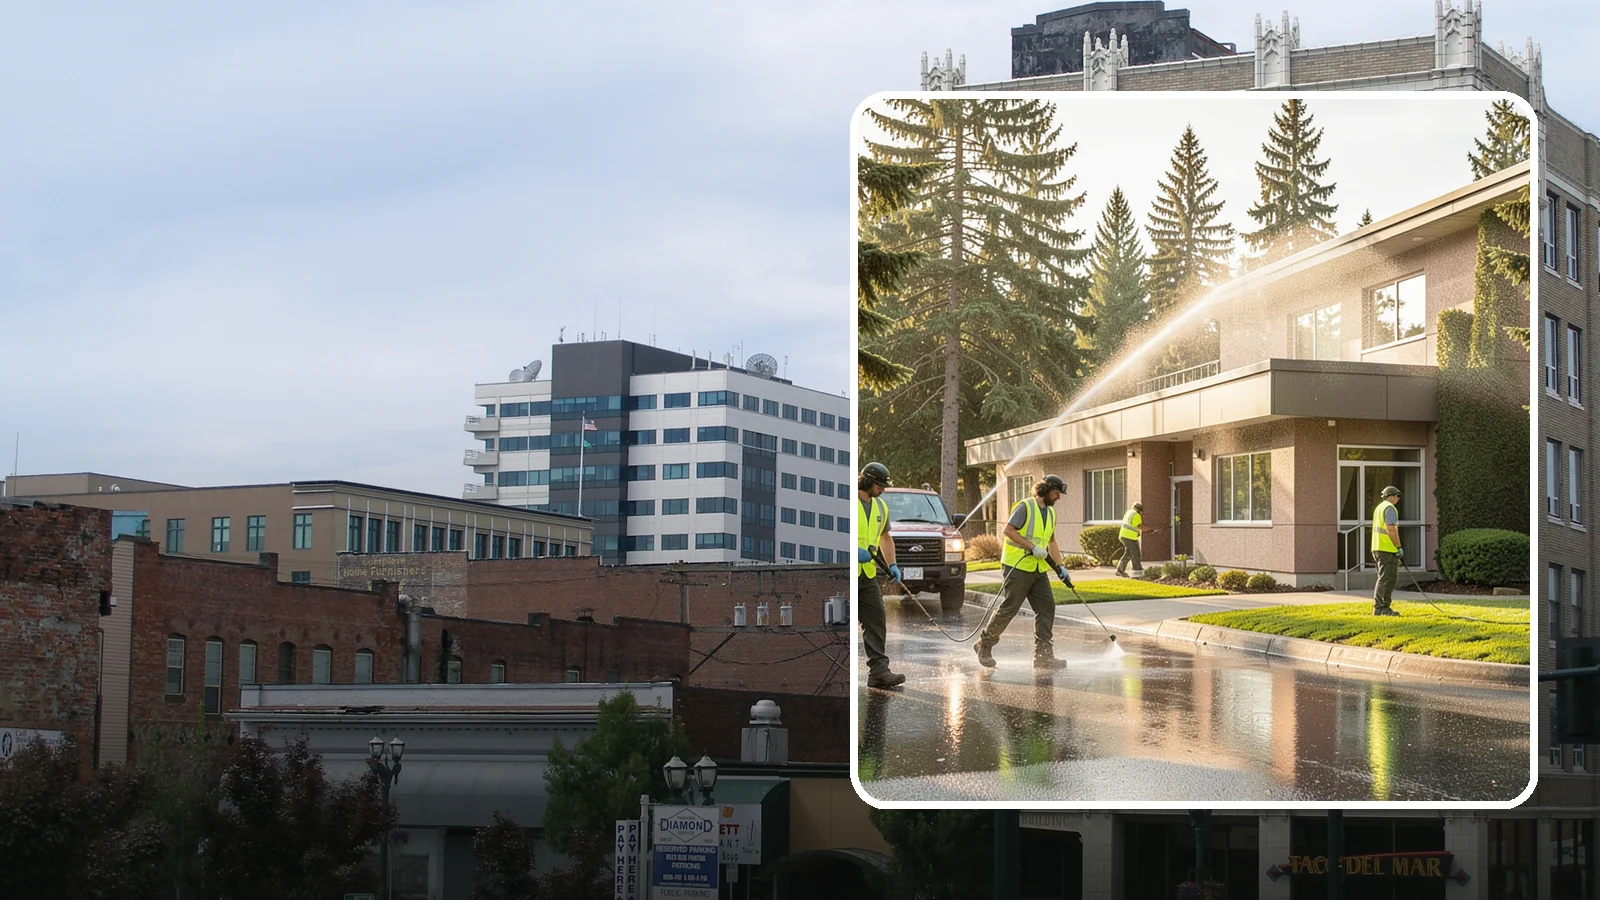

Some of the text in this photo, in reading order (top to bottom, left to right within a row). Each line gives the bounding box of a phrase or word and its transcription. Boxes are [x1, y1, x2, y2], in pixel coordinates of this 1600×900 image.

[343, 566, 427, 577] Home Furnishers
[660, 818, 713, 833] DIAMOND
[1022, 815, 1069, 828] BUILDING
[656, 845, 716, 854] RESERVED PARKING
[616, 825, 625, 893] PAY HERE
[628, 824, 637, 893] PAY HERE
[721, 851, 739, 862] Soup
[671, 862, 701, 870] PATRONS
[1346, 855, 1385, 876] DEL
[1393, 857, 1442, 877] MAR
[660, 888, 710, 898] PUBLIC PARKING
